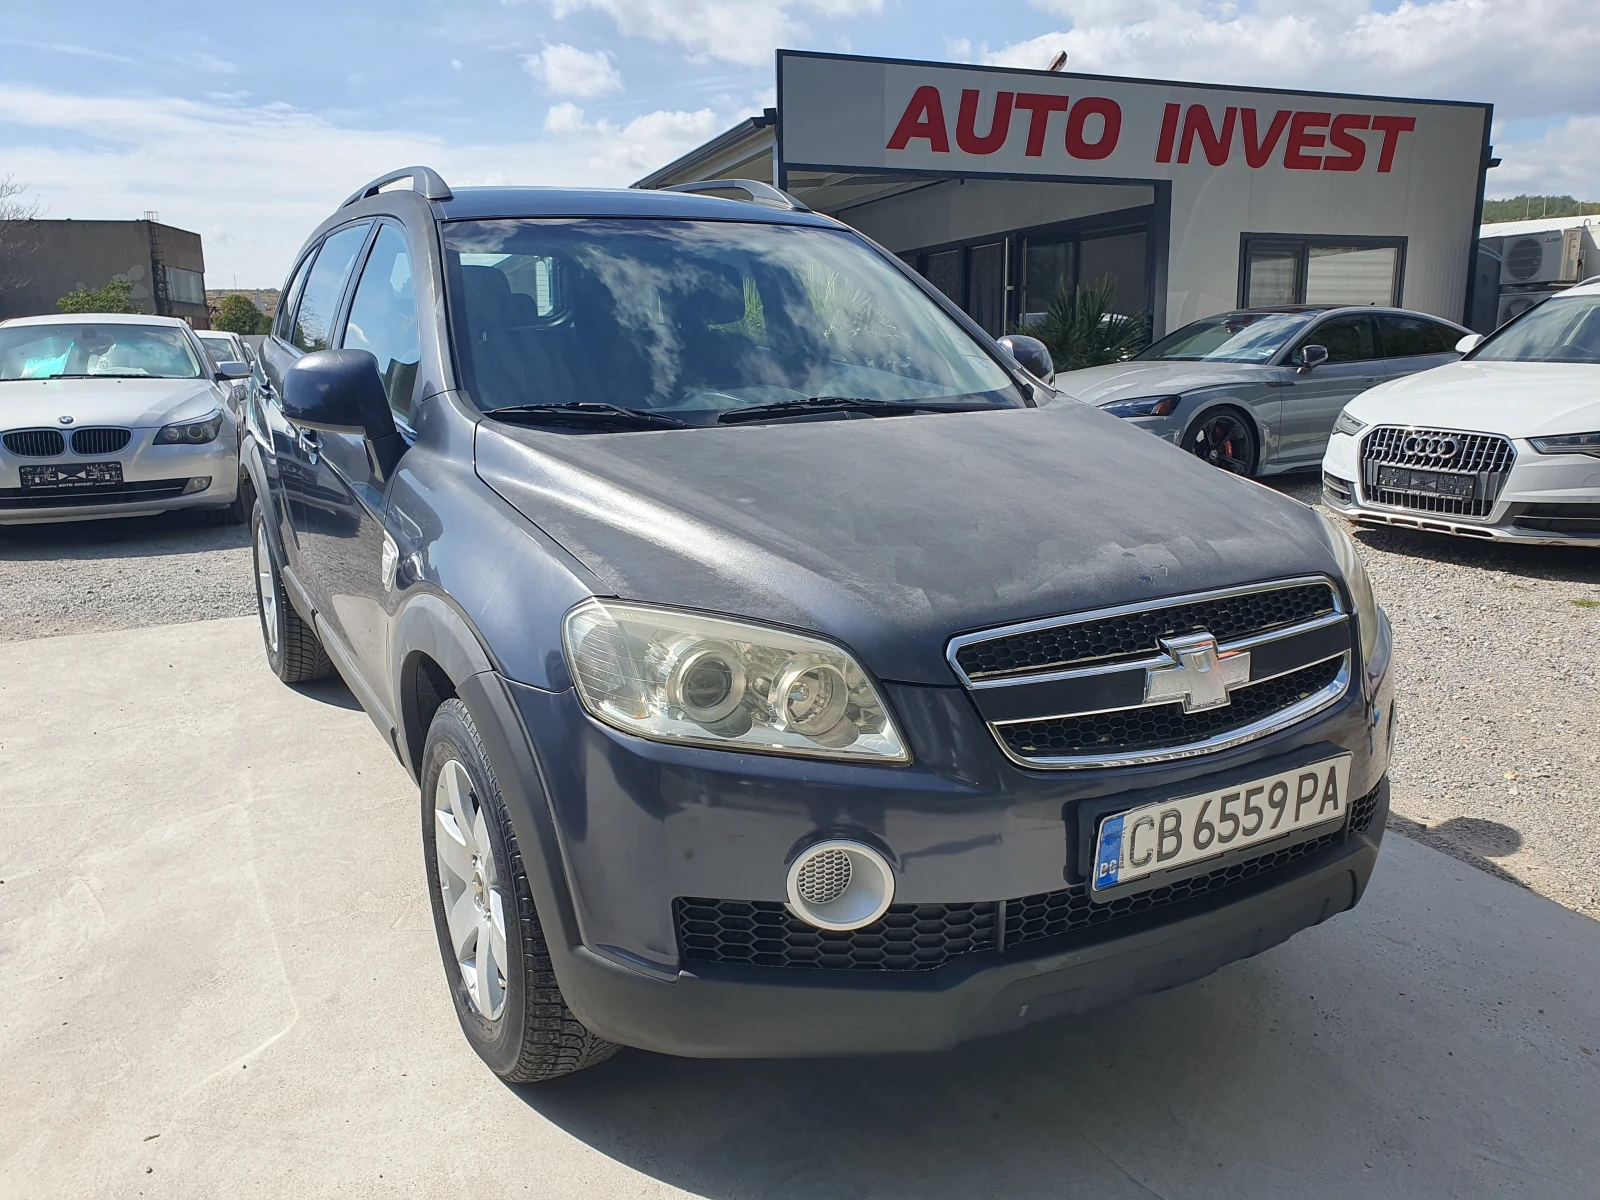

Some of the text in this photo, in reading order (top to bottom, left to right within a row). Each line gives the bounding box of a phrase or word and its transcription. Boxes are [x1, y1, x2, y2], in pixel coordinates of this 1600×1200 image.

[886, 85, 1416, 173] AUTO INVEST
[1129, 766, 1339, 868] CB 6559 PA
